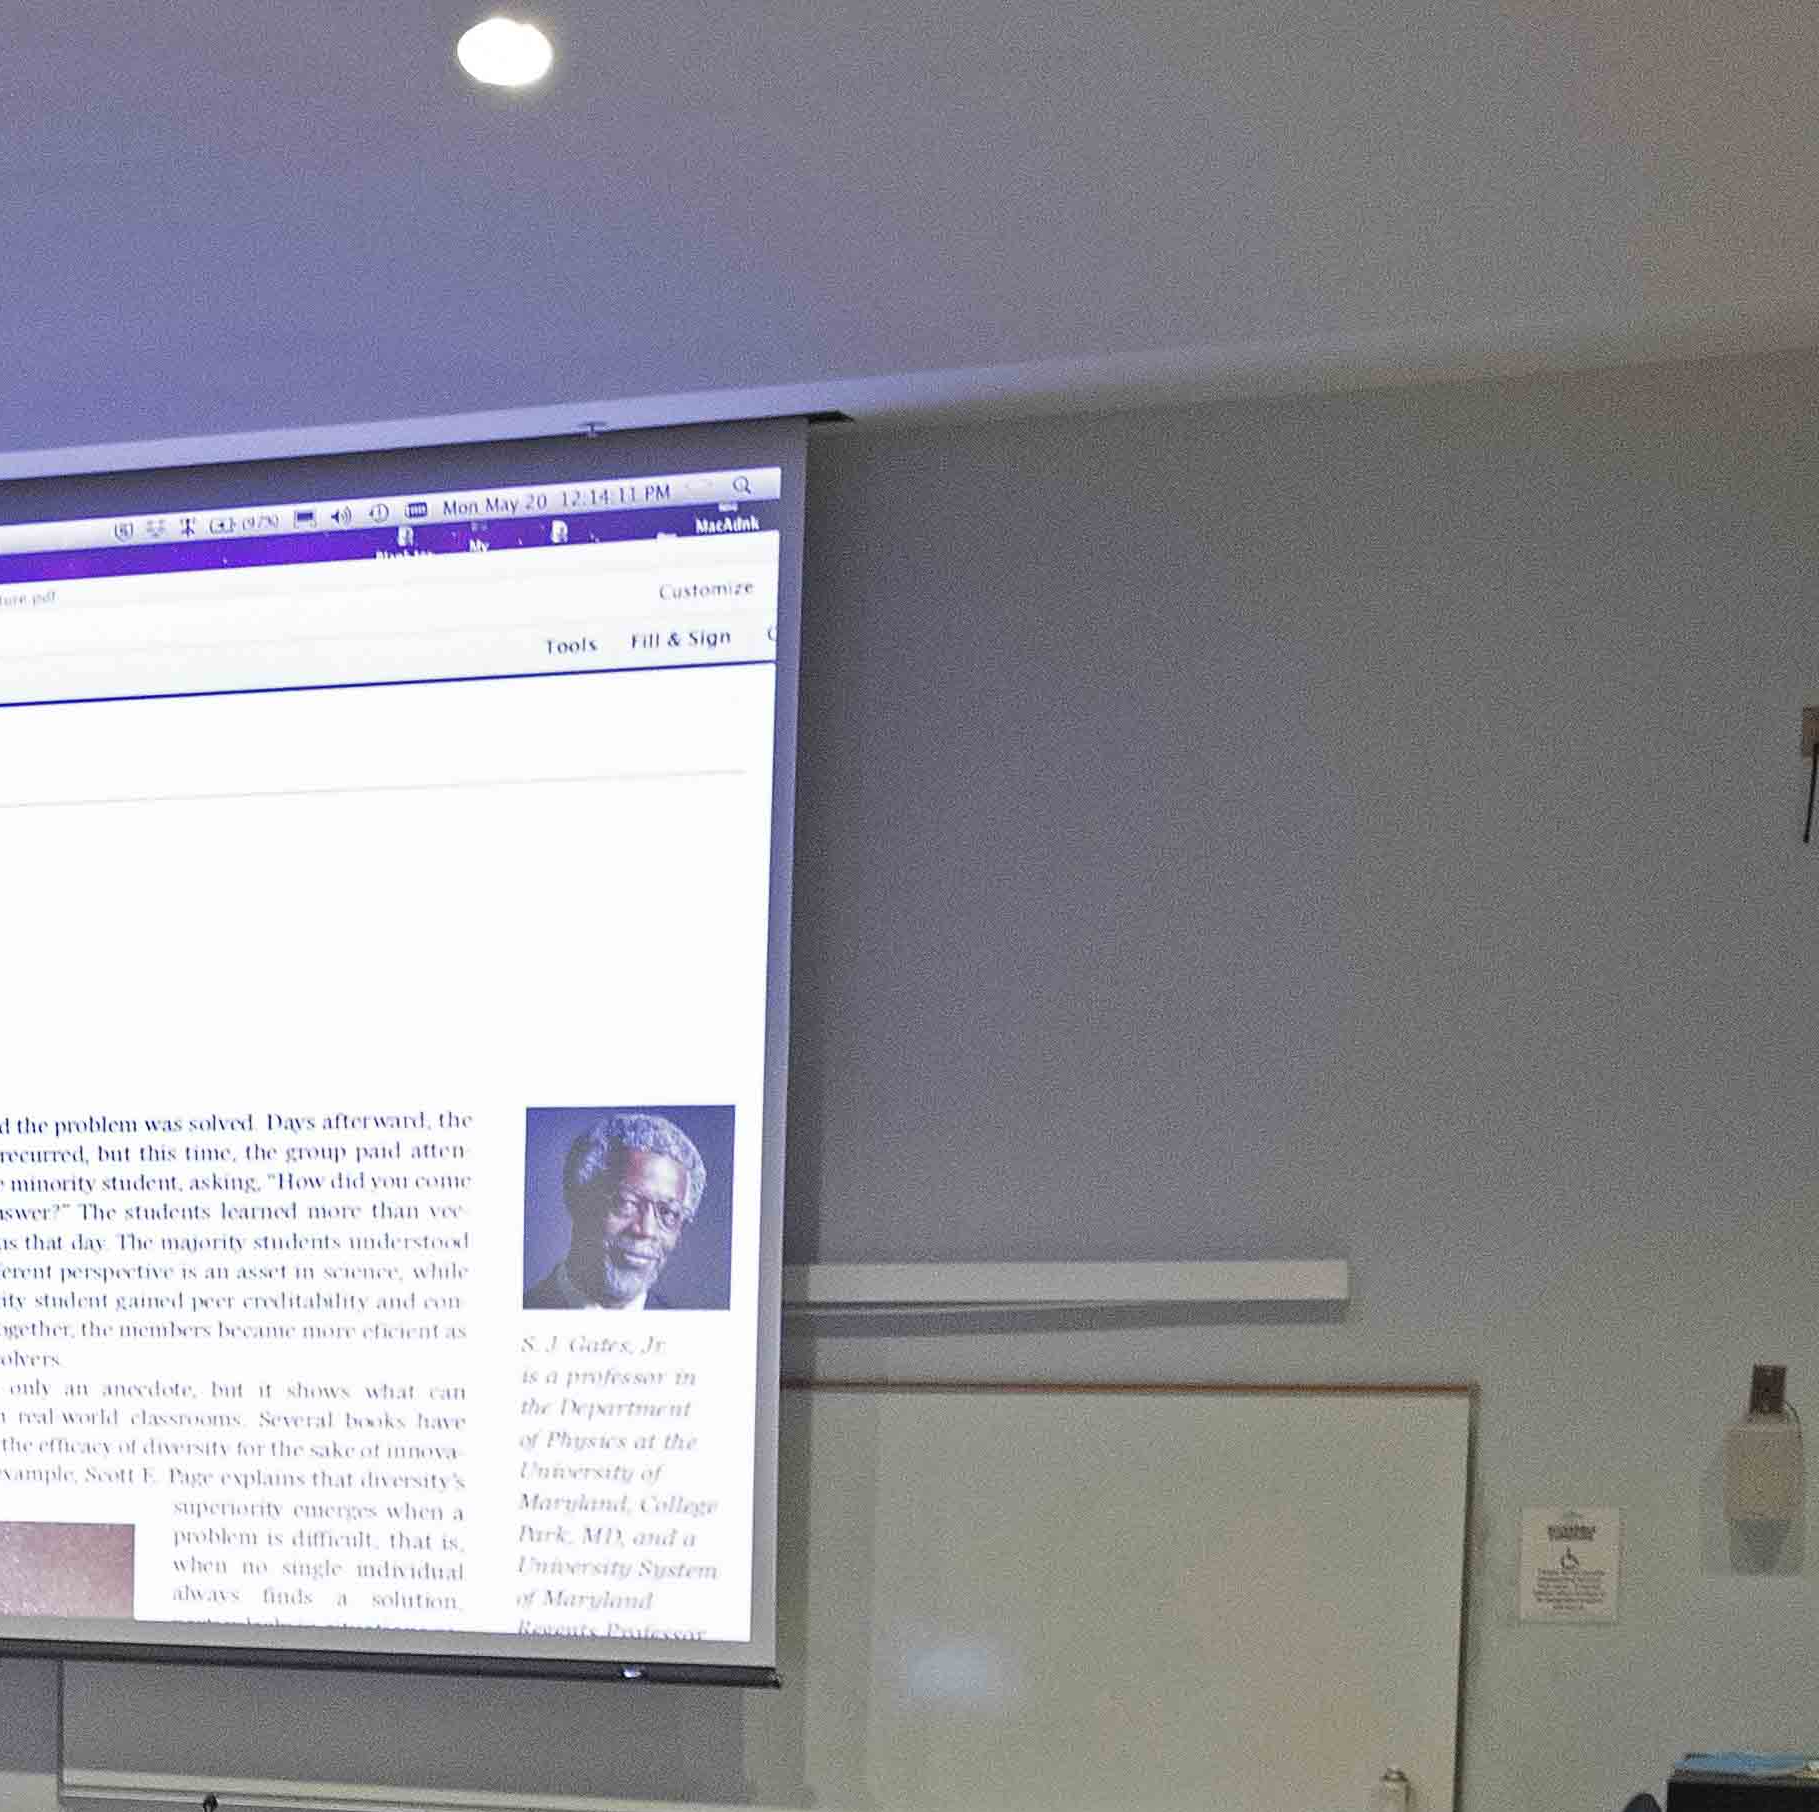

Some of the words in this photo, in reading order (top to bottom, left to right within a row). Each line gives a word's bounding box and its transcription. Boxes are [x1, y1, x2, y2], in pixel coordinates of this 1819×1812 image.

[443, 500, 479, 515] Mon
[484, 495, 520, 512] May
[525, 492, 548, 509] 20
[644, 484, 671, 501] PM
[659, 581, 755, 600] Customize
[546, 637, 599, 655] Tools
[630, 632, 660, 648] Fill
[667, 632, 680, 646] &
[688, 630, 732, 649] Sign
[17, 1116, 48, 1134] the
[55, 1115, 137, 1137] problem
[145, 1120, 182, 1132] was
[268, 1114, 315, 1133] Days
[323, 1112, 430, 1129] afterward,
[439, 1112, 472, 1128] the
[0, 1145, 89, 1165] recurred,
[99, 1145, 129, 1162] but
[140, 1145, 176, 1161] this
[185, 1147, 235, 1162] time,
[246, 1144, 277, 1160] the
[286, 1147, 346, 1163] group
[356, 1141, 400, 1163] paid
[12, 1176, 95, 1193] minority
[102, 1174, 182, 1192] student,
[190, 1173, 260, 1193] asking,
[331, 1172, 363, 1189] did
[371, 1177, 407, 1189] you
[415, 1176, 471, 1188] come
[78, 1203, 116, 1221] The
[125, 1203, 210, 1220] students
[222, 1202, 296, 1220] learned
[309, 1207, 361, 1219] more
[372, 1201, 418, 1219] than
[569, 1335, 634, 1354] Gates,
[523, 1370, 539, 1384] is
[546, 1371, 558, 1384] a
[566, 1369, 667, 1389] professor
[675, 1368, 696, 1386] in
[521, 1397, 550, 1416] the
[561, 1397, 691, 1421] Department
[519, 1430, 541, 1450] of
[547, 1430, 627, 1452] Physics
[635, 1432, 659, 1450] at
[664, 1432, 697, 1451] the
[520, 1461, 635, 1484] University
[641, 1464, 665, 1486] of
[519, 1493, 632, 1516] Maryland,
[641, 1496, 718, 1518] College
[519, 1525, 573, 1544] Park,
[582, 1526, 625, 1548] MD,
[633, 1528, 678, 1547] and
[682, 1532, 696, 1547] a
[518, 1556, 631, 1576] University
[639, 1559, 718, 1581] System
[516, 1591, 539, 1608] of
[544, 1589, 653, 1611] Maryland
